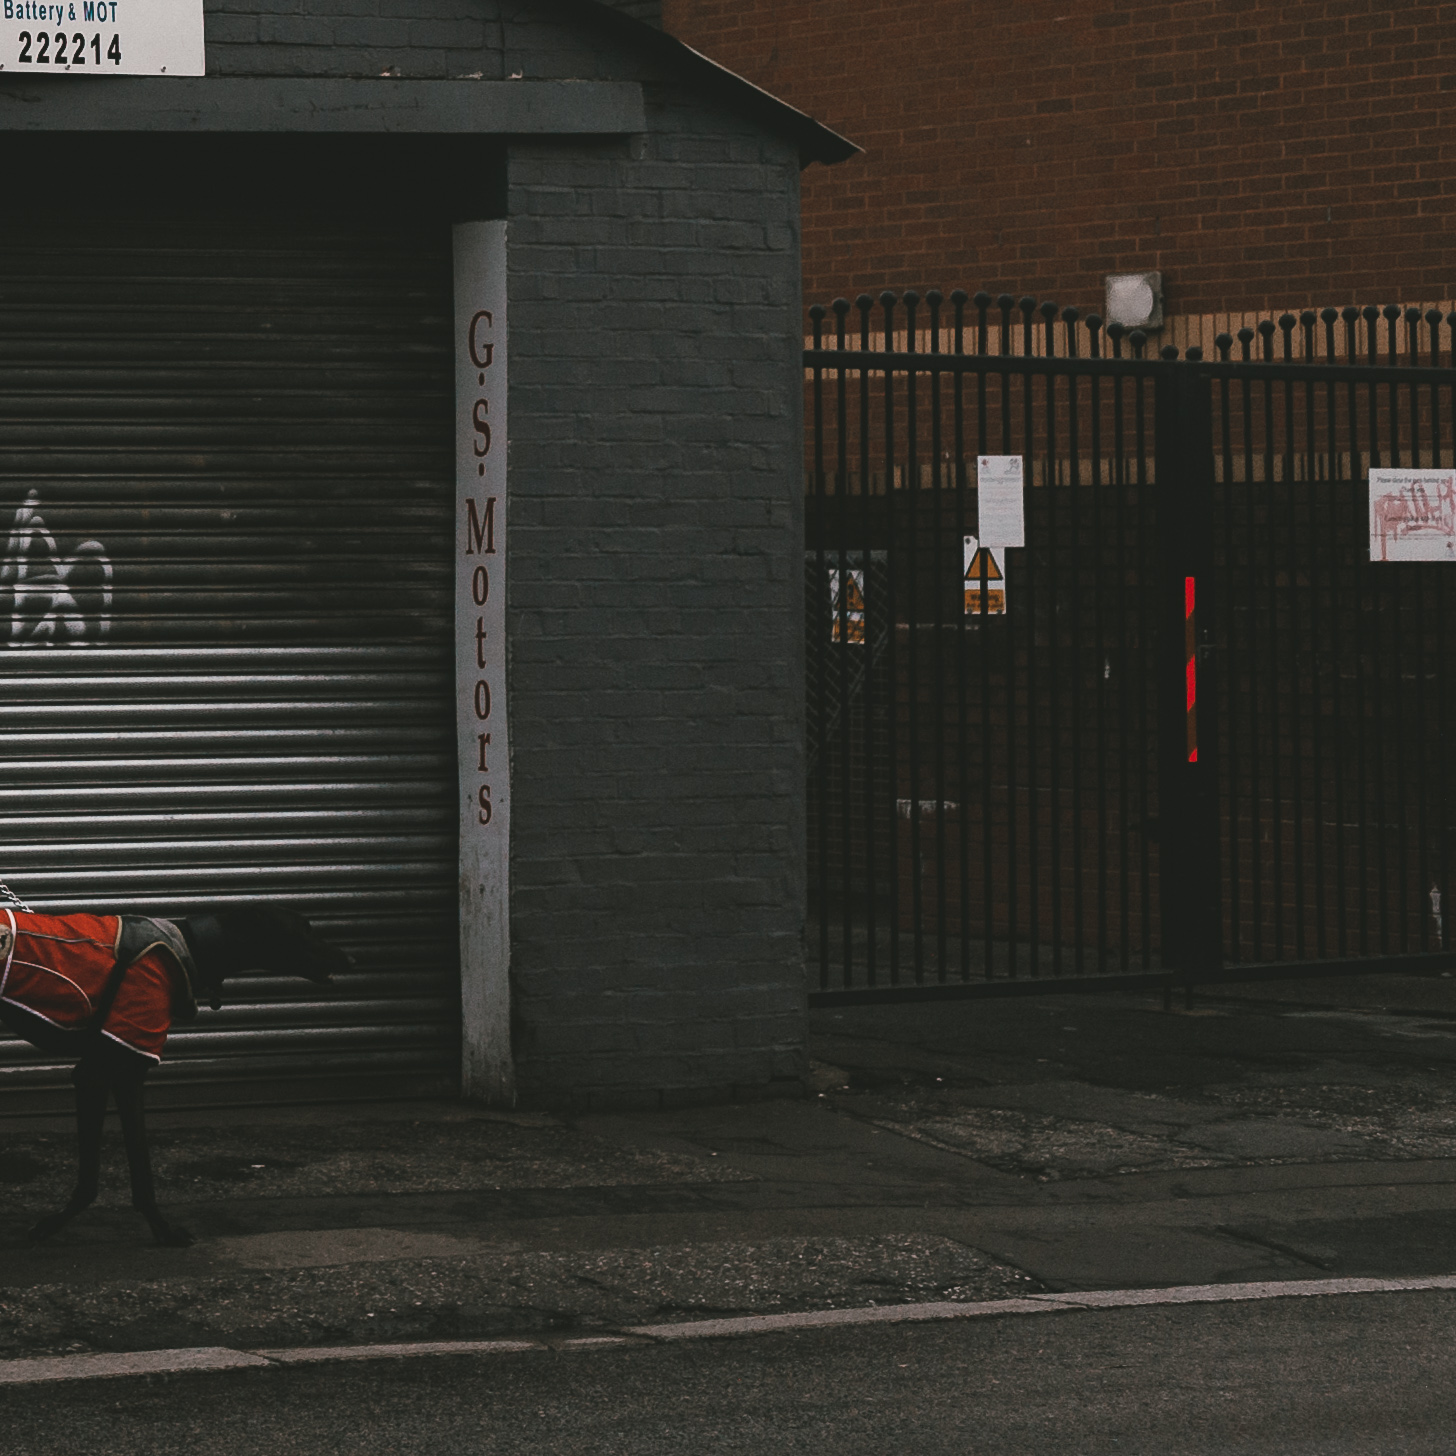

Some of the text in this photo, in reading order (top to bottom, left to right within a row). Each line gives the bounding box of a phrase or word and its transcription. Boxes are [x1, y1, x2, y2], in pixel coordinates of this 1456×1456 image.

[4, 0, 63, 26] Battery
[68, 4, 76, 20] &
[84, 2, 117, 22] MOT
[19, 32, 121, 65] 222214
[465, 498, 496, 825] Motors
